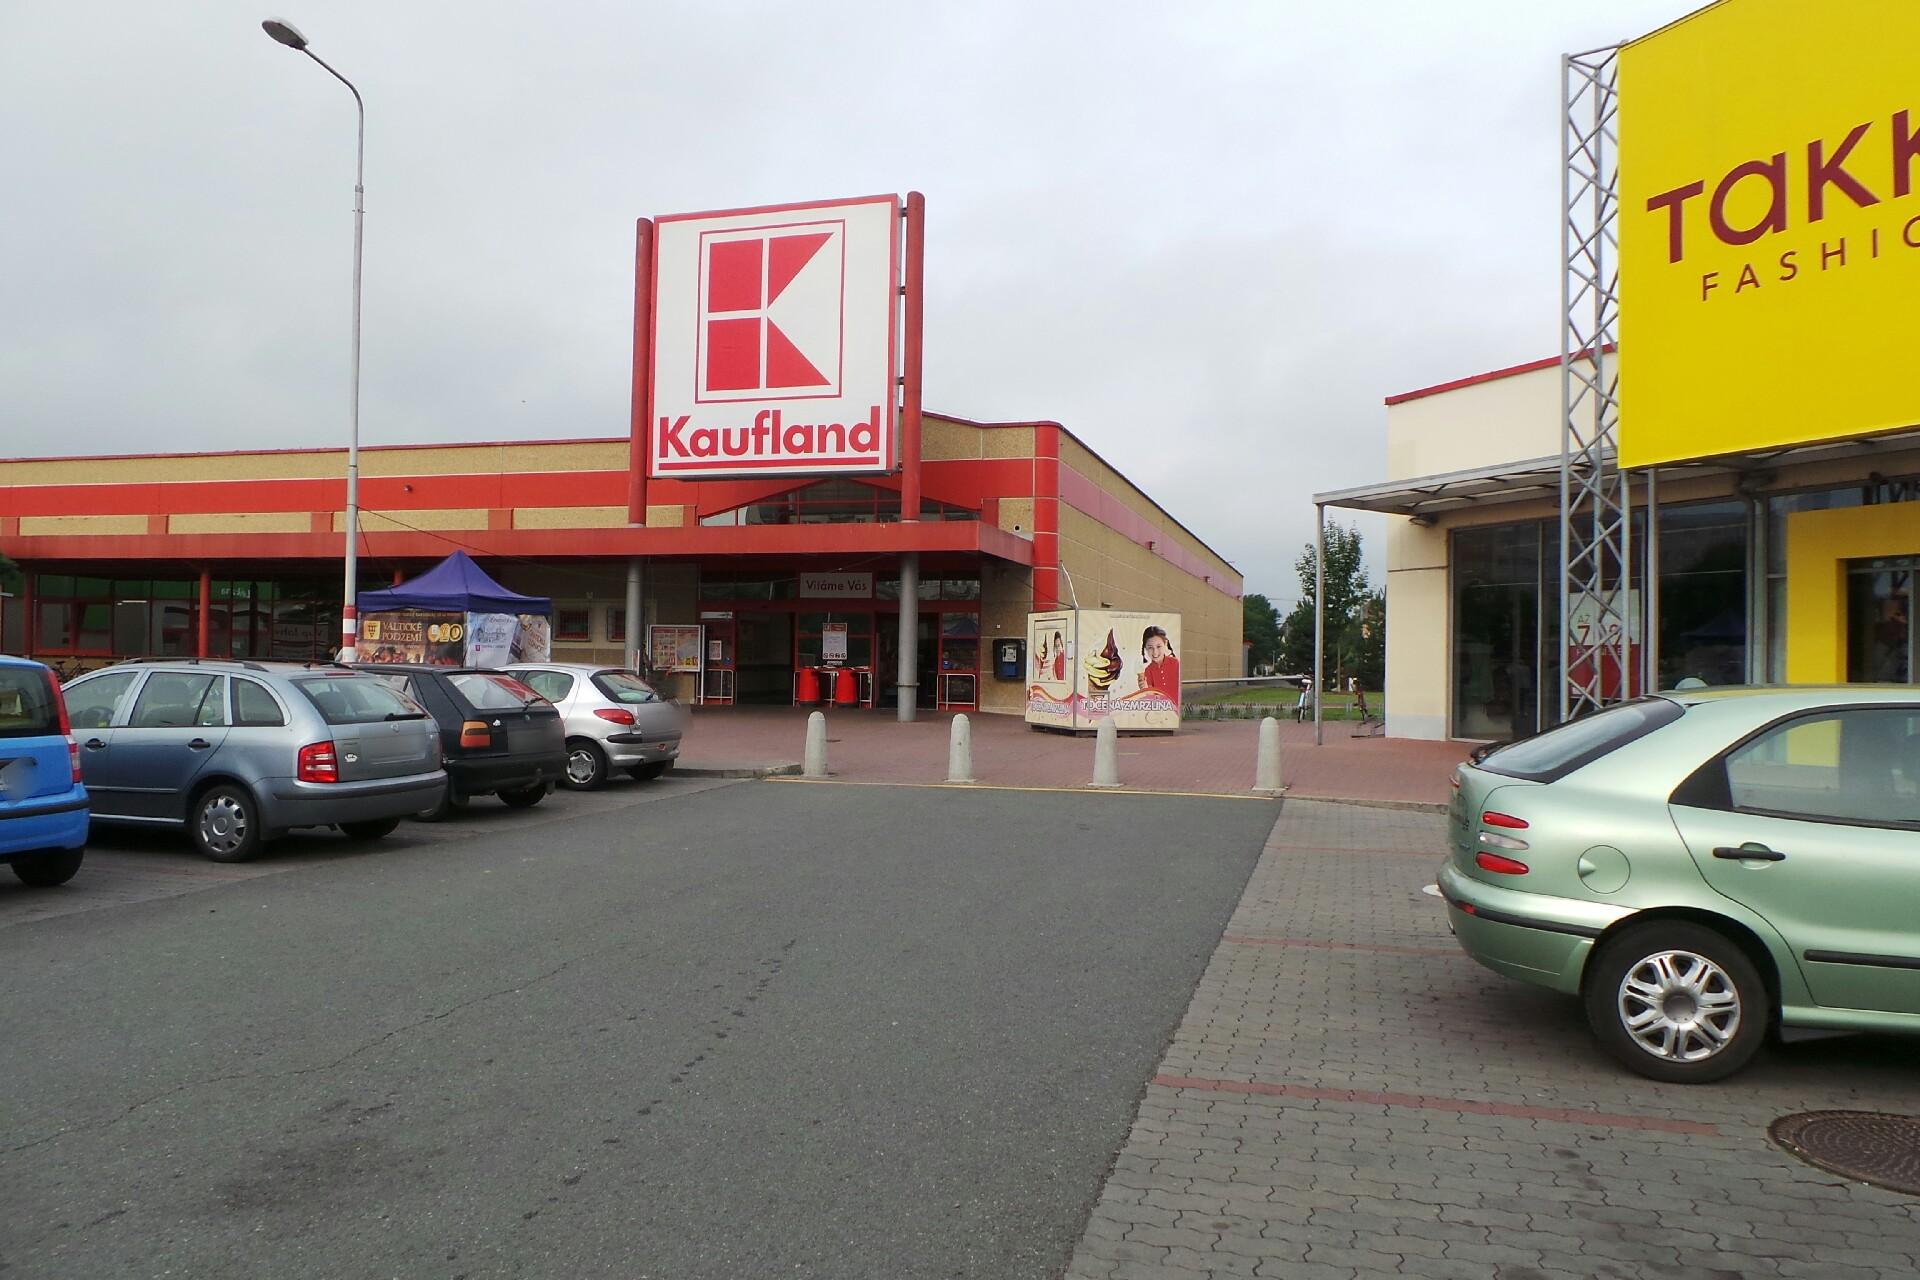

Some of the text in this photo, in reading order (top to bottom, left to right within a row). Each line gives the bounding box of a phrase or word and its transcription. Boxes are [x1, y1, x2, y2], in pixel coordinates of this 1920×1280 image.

[658, 405, 881, 458] Kaufland
[847, 578, 868, 591] Vás
[383, 621, 423, 632] VALTICKÉ
[382, 631, 423, 642] PODZEMÍ
[1122, 700, 1174, 712] ZMRZLINA
